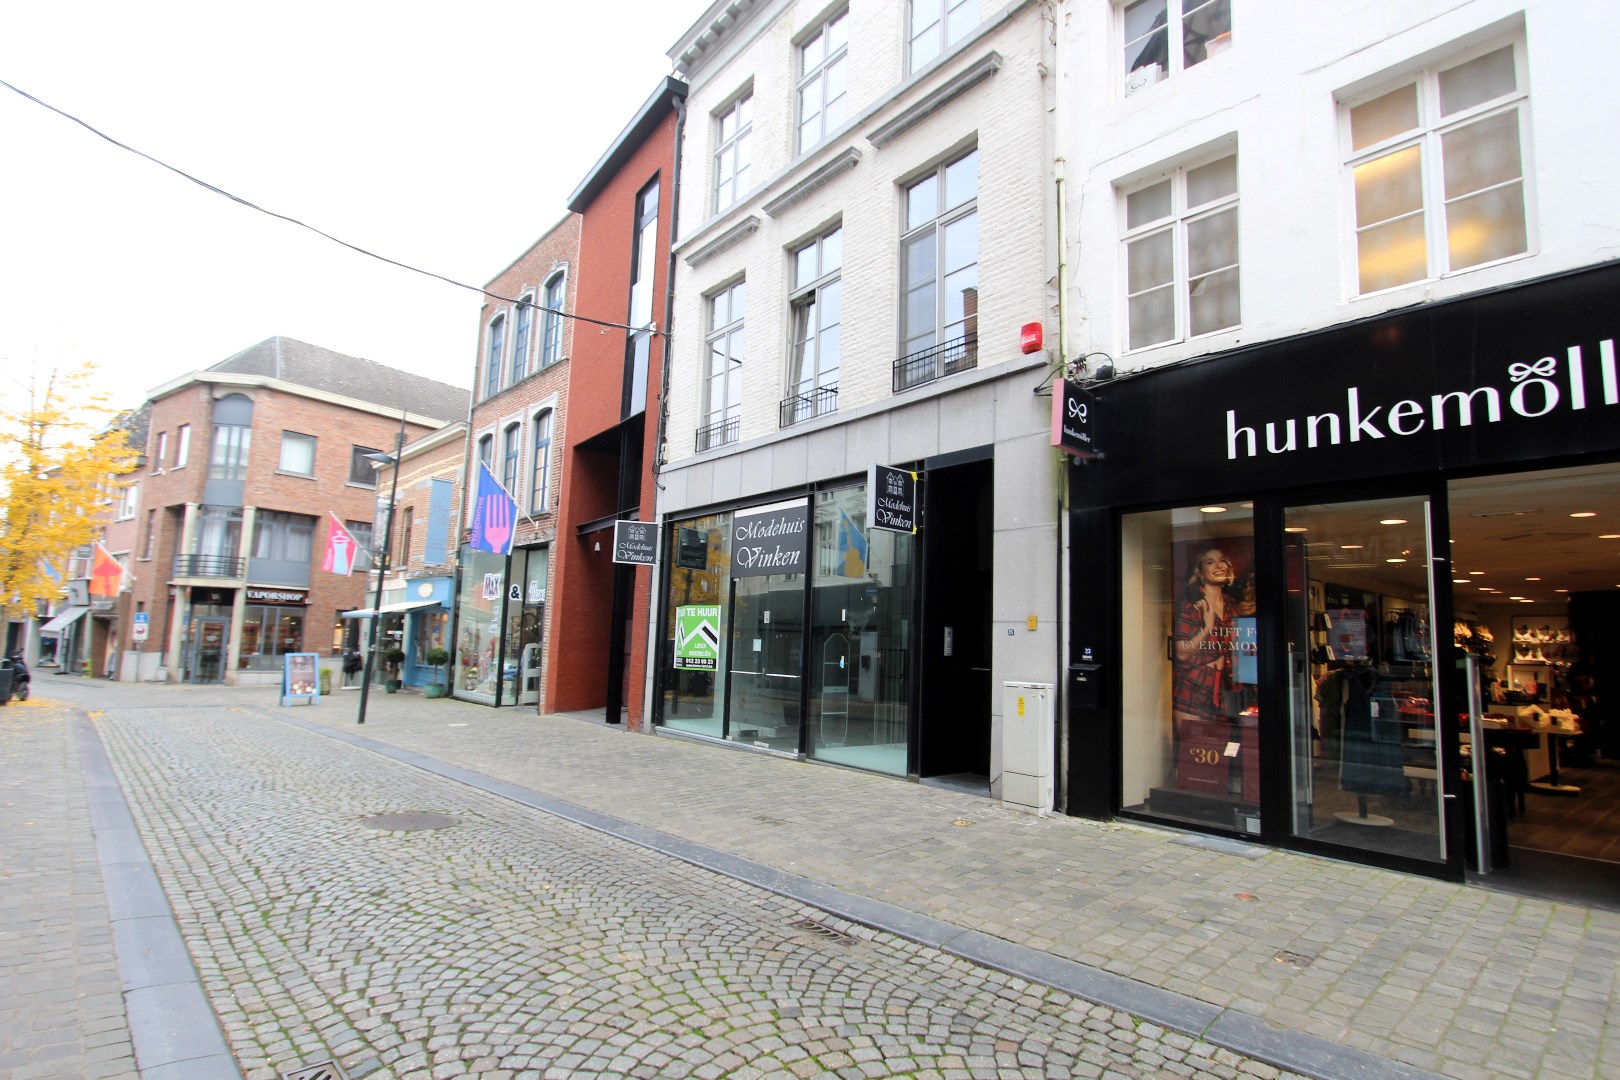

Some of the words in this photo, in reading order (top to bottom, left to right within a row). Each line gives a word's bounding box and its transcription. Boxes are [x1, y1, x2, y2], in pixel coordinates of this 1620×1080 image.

[877, 497, 912, 512] Modehuis
[876, 508, 912, 529] Vinken
[735, 517, 805, 541] Modehuis
[618, 542, 654, 552] Modehuis
[617, 550, 654, 562] Vinken
[736, 545, 801, 569] Vinken
[246, 591, 303, 601] VAPORSHOP
[686, 607, 696, 617] TE
[697, 607, 718, 617] HUUR
[1209, 627, 1242, 637] GIFT
[1182, 641, 1226, 651] EVERY
